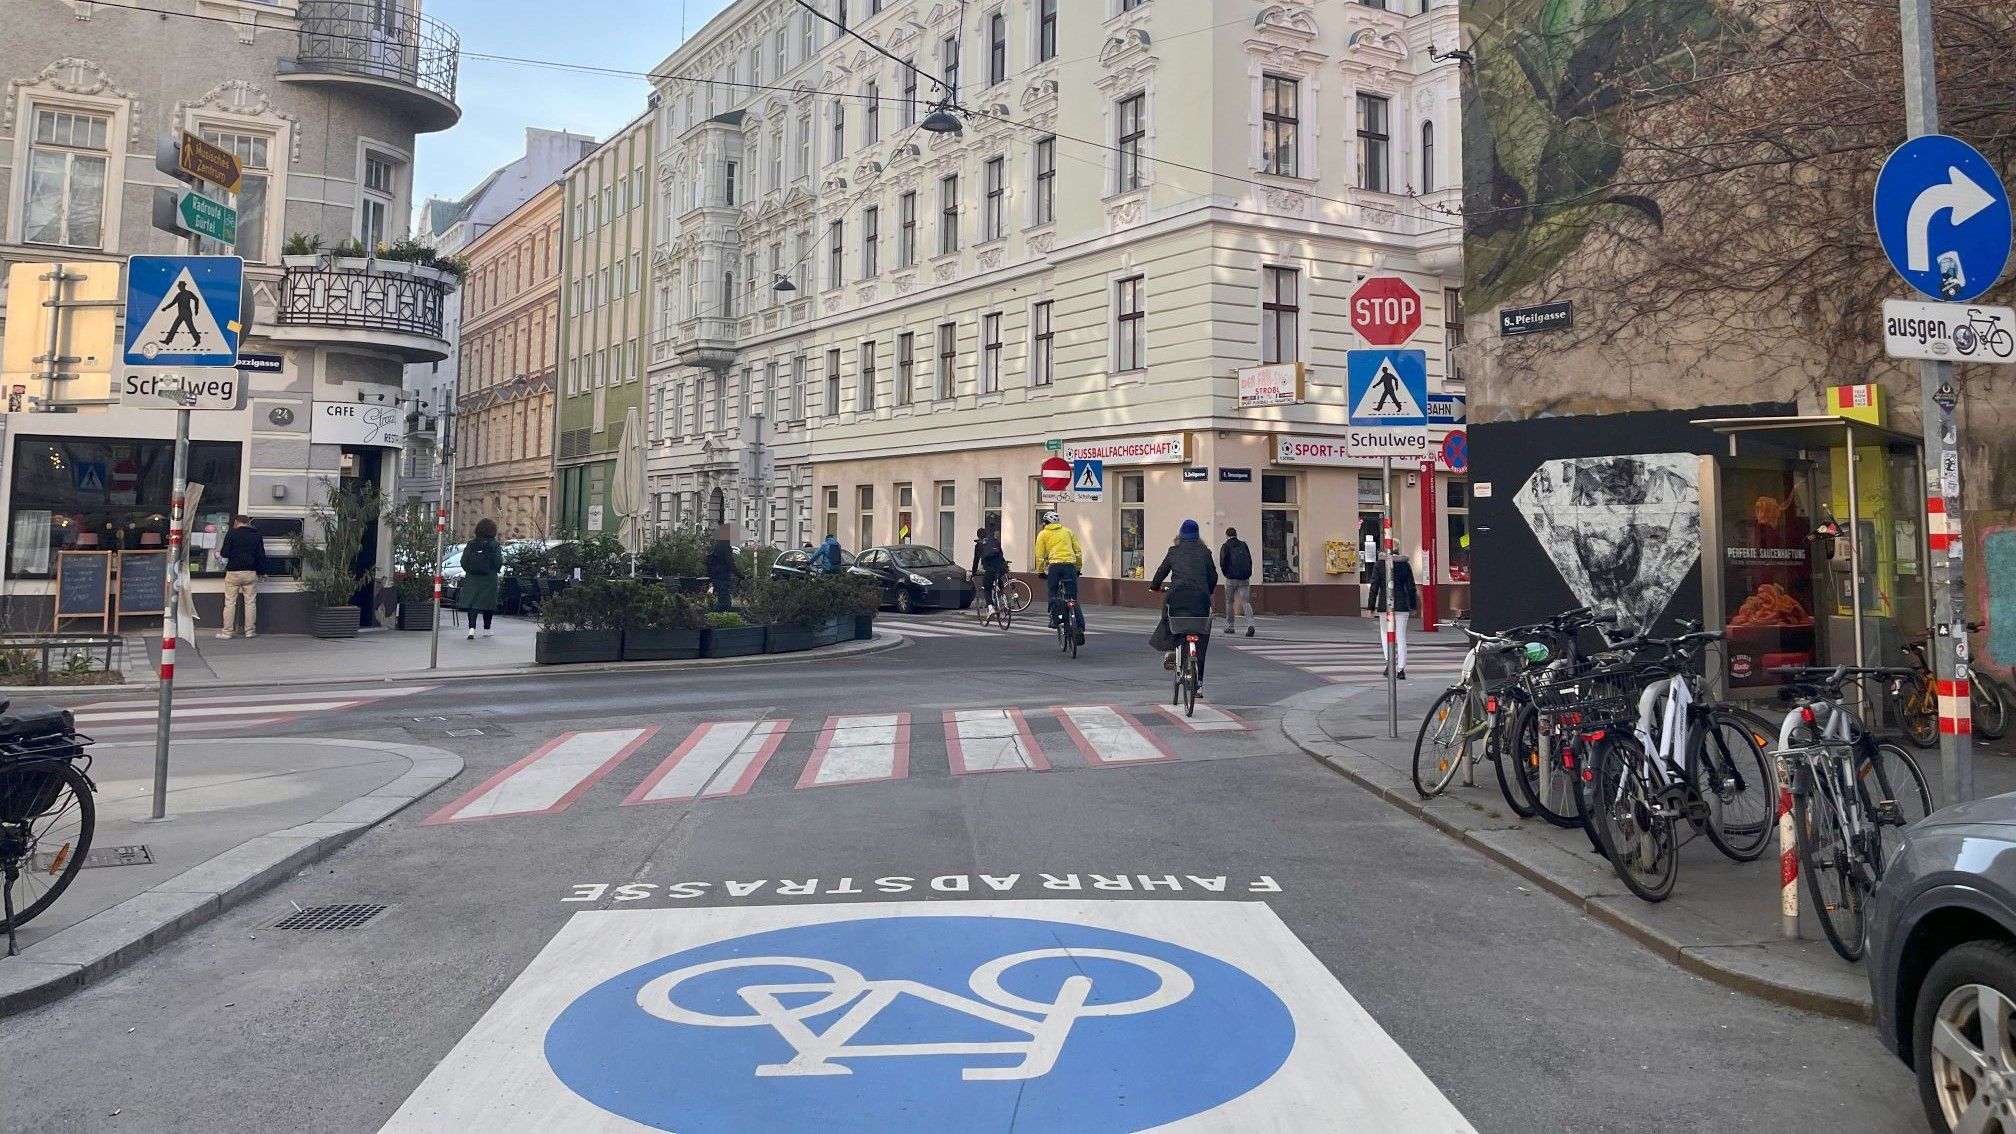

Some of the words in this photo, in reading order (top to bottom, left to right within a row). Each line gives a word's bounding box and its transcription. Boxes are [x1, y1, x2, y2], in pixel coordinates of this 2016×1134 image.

[192, 196, 221, 219] Radroute
[1355, 297, 1416, 326] STOP
[1515, 311, 1566, 325] Pfeilgasse
[1887, 317, 1951, 345] ausgen.
[238, 358, 280, 369] ozzigasse
[125, 375, 233, 400] Schlweg
[1255, 386, 1280, 396] STROBL
[276, 408, 289, 420] 24
[326, 405, 355, 417] CAFE
[1428, 402, 1451, 415] BAHN
[1351, 432, 1426, 449] Schulweg
[1727, 547, 1757, 559] PERFEKTE
[561, 873, 1284, 902] FAHRRADSTRASSE
